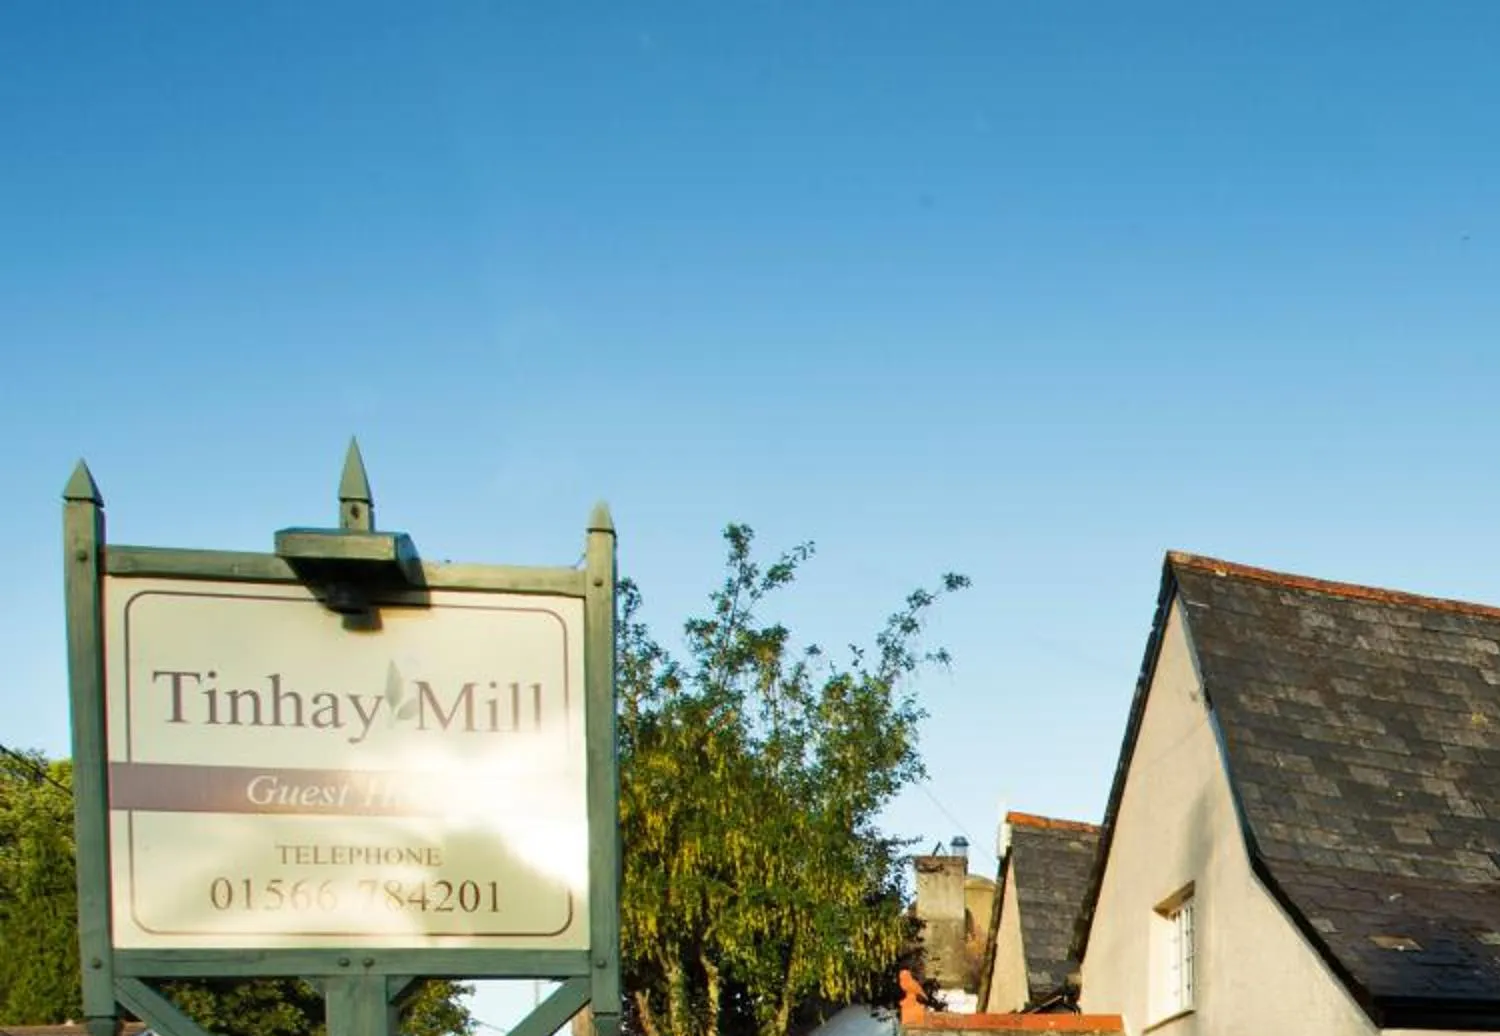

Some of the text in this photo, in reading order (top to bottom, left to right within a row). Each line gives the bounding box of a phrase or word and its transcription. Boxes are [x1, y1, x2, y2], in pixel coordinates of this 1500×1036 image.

[152, 669, 543, 744] Tinhay Mill
[246, 774, 350, 807] Guest
[275, 844, 444, 867] TELEPHONE
[210, 876, 501, 913] 01566 784201
